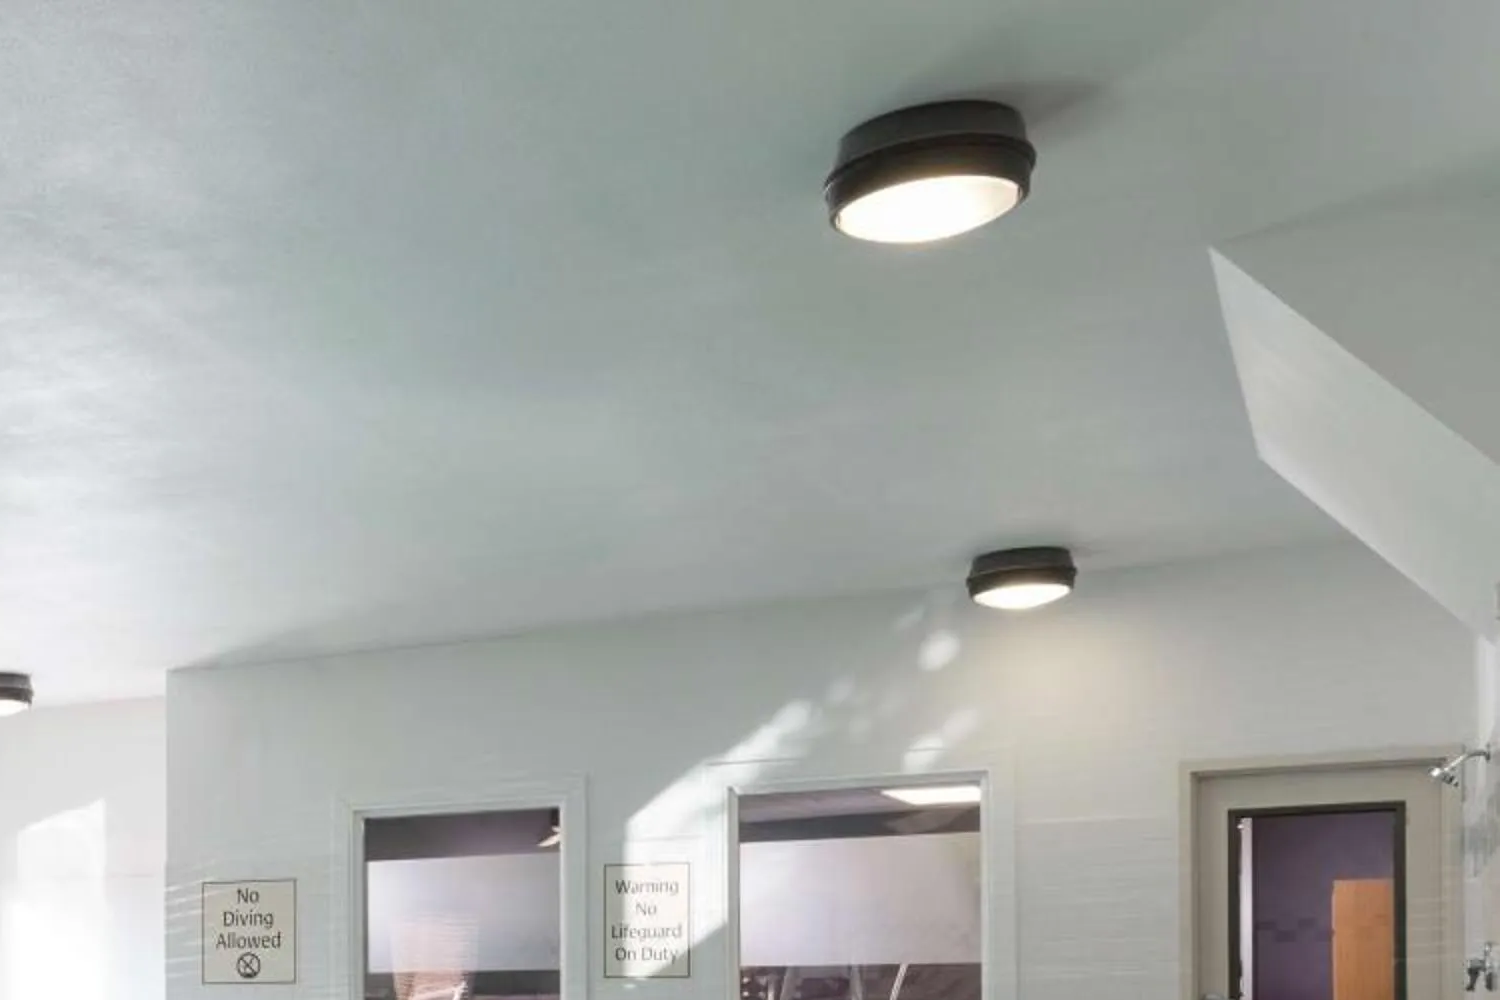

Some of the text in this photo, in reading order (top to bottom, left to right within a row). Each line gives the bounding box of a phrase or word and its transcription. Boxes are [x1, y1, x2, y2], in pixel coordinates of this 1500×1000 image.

[237, 888, 260, 904] No
[615, 879, 680, 896] Warning
[635, 901, 657, 916] No
[222, 909, 274, 929] Diving
[215, 931, 281, 949] Allowed
[611, 921, 683, 942] Lifeguard
[615, 947, 678, 965] On Duty
